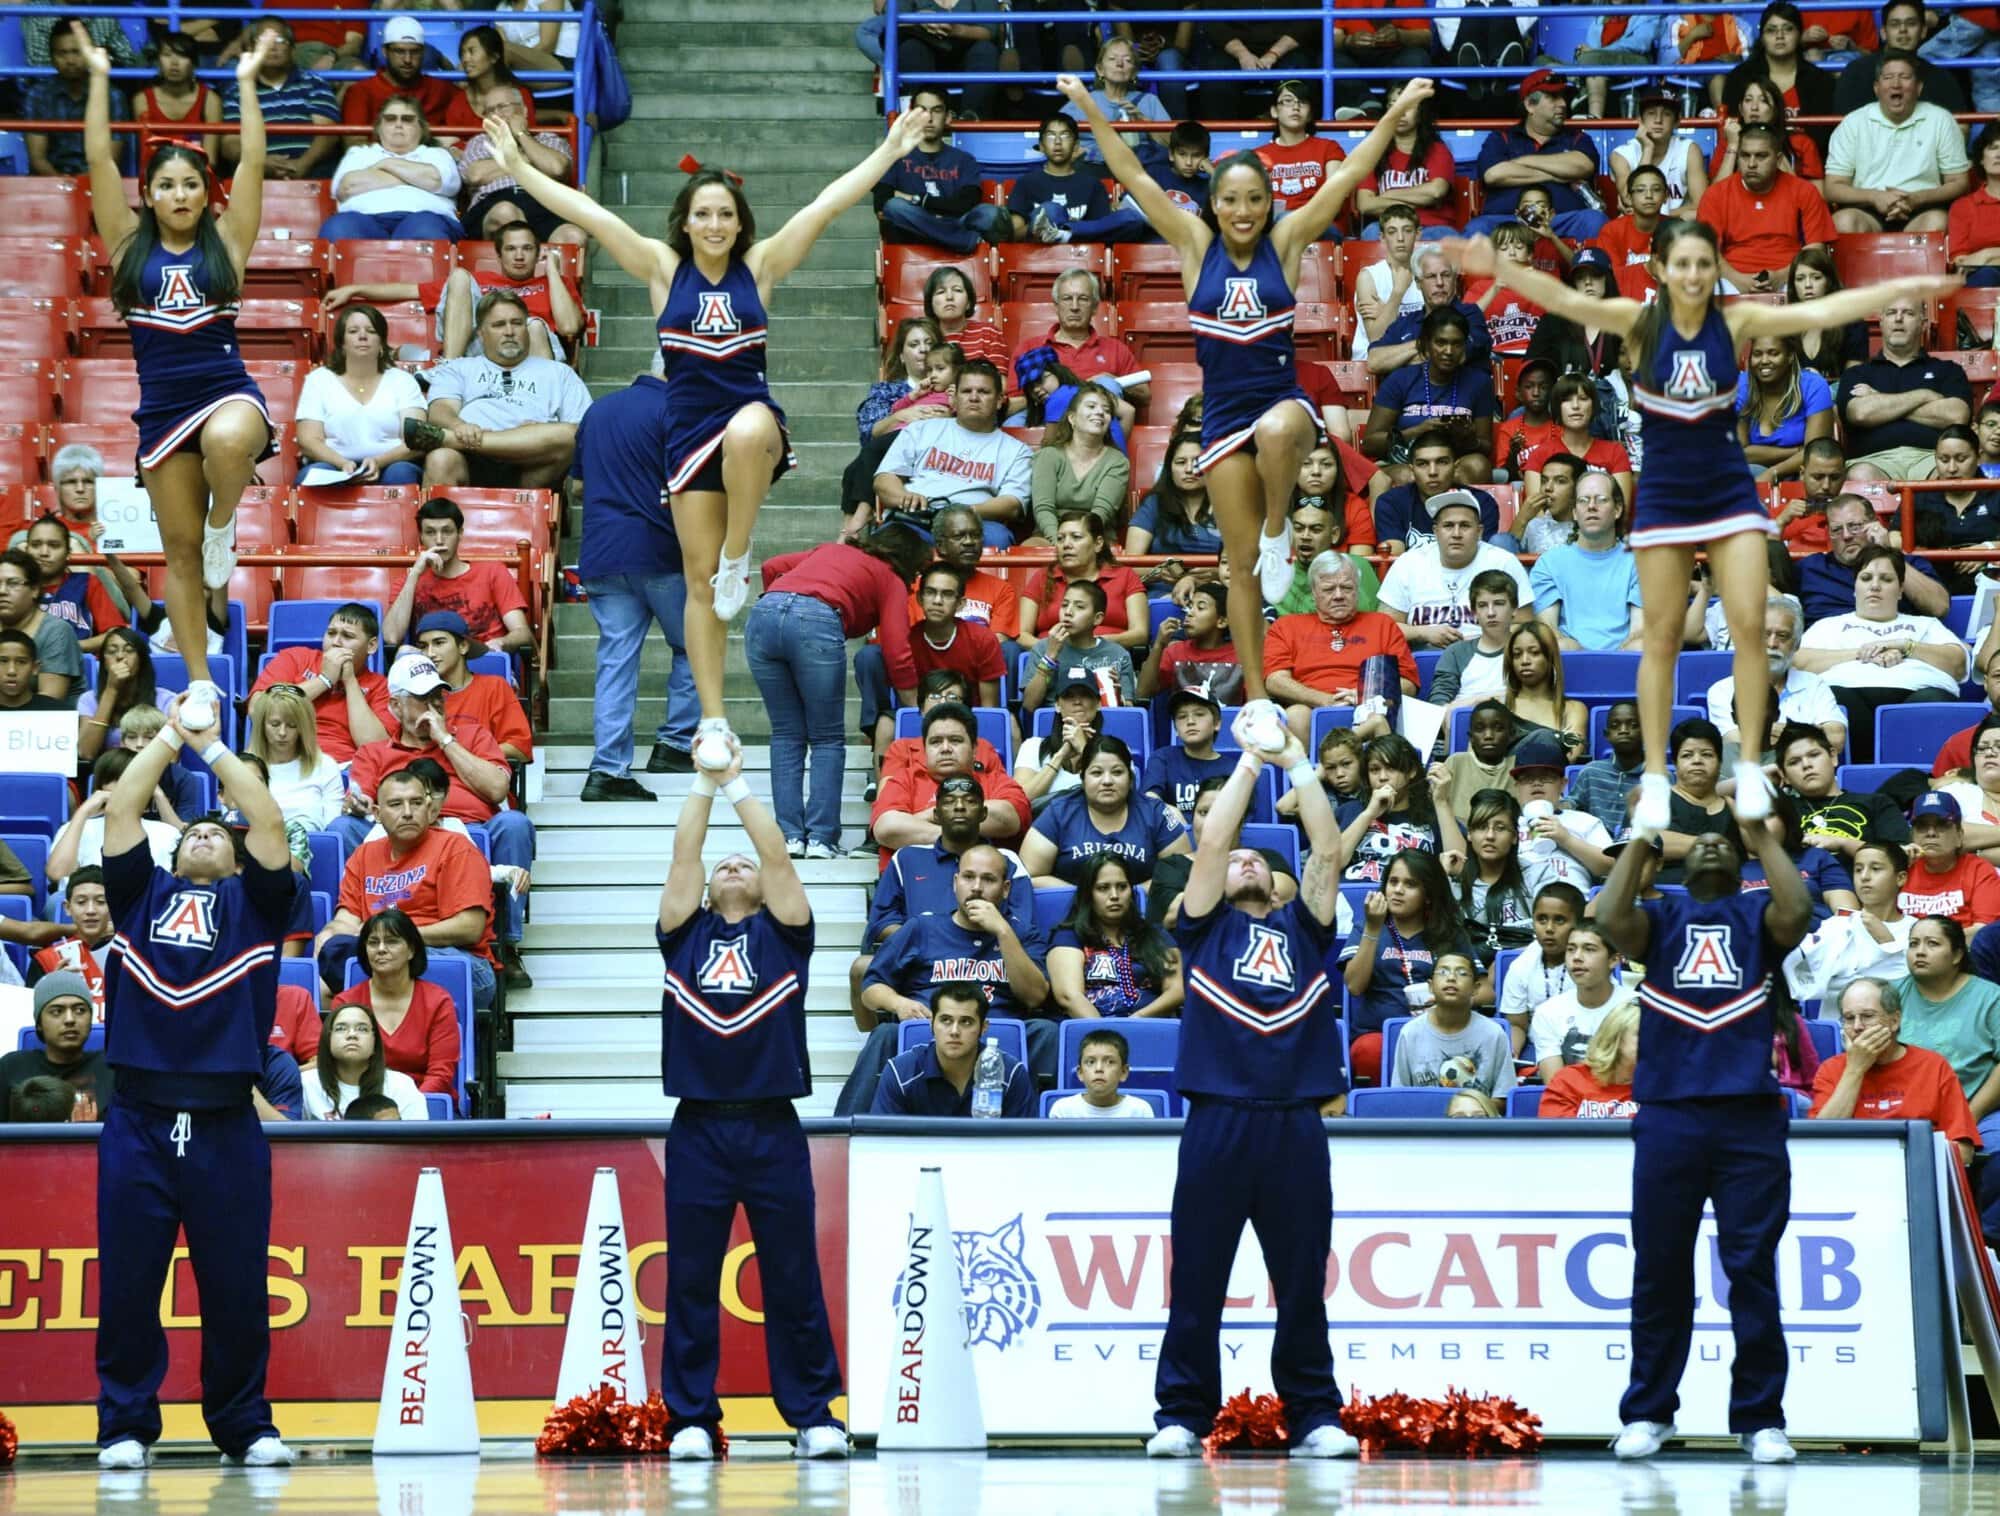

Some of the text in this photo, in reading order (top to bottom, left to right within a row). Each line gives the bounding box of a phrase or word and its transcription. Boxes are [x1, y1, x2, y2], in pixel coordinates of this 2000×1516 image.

[155, 265, 206, 310] A
[1218, 277, 1267, 320] A
[691, 292, 741, 336] A
[1664, 351, 1717, 398] A
[923, 446, 996, 484] ARIZONA
[101, 499, 139, 522] Go
[1411, 605, 1480, 628] ARIZON
[8, 729, 70, 751] Blue
[1175, 782, 1199, 803] LO
[1072, 841, 1146, 862] ARIZONA
[364, 866, 427, 895] ARZONA
[150, 890, 219, 950] A
[697, 934, 758, 994] A
[930, 957, 1009, 983] ARIZON
[1233, 923, 1295, 992] A
[1673, 925, 1743, 989] A
[0, 1245, 310, 1330] ELS
[1054, 1342, 1857, 1363] EVEY EMBER CUTS
